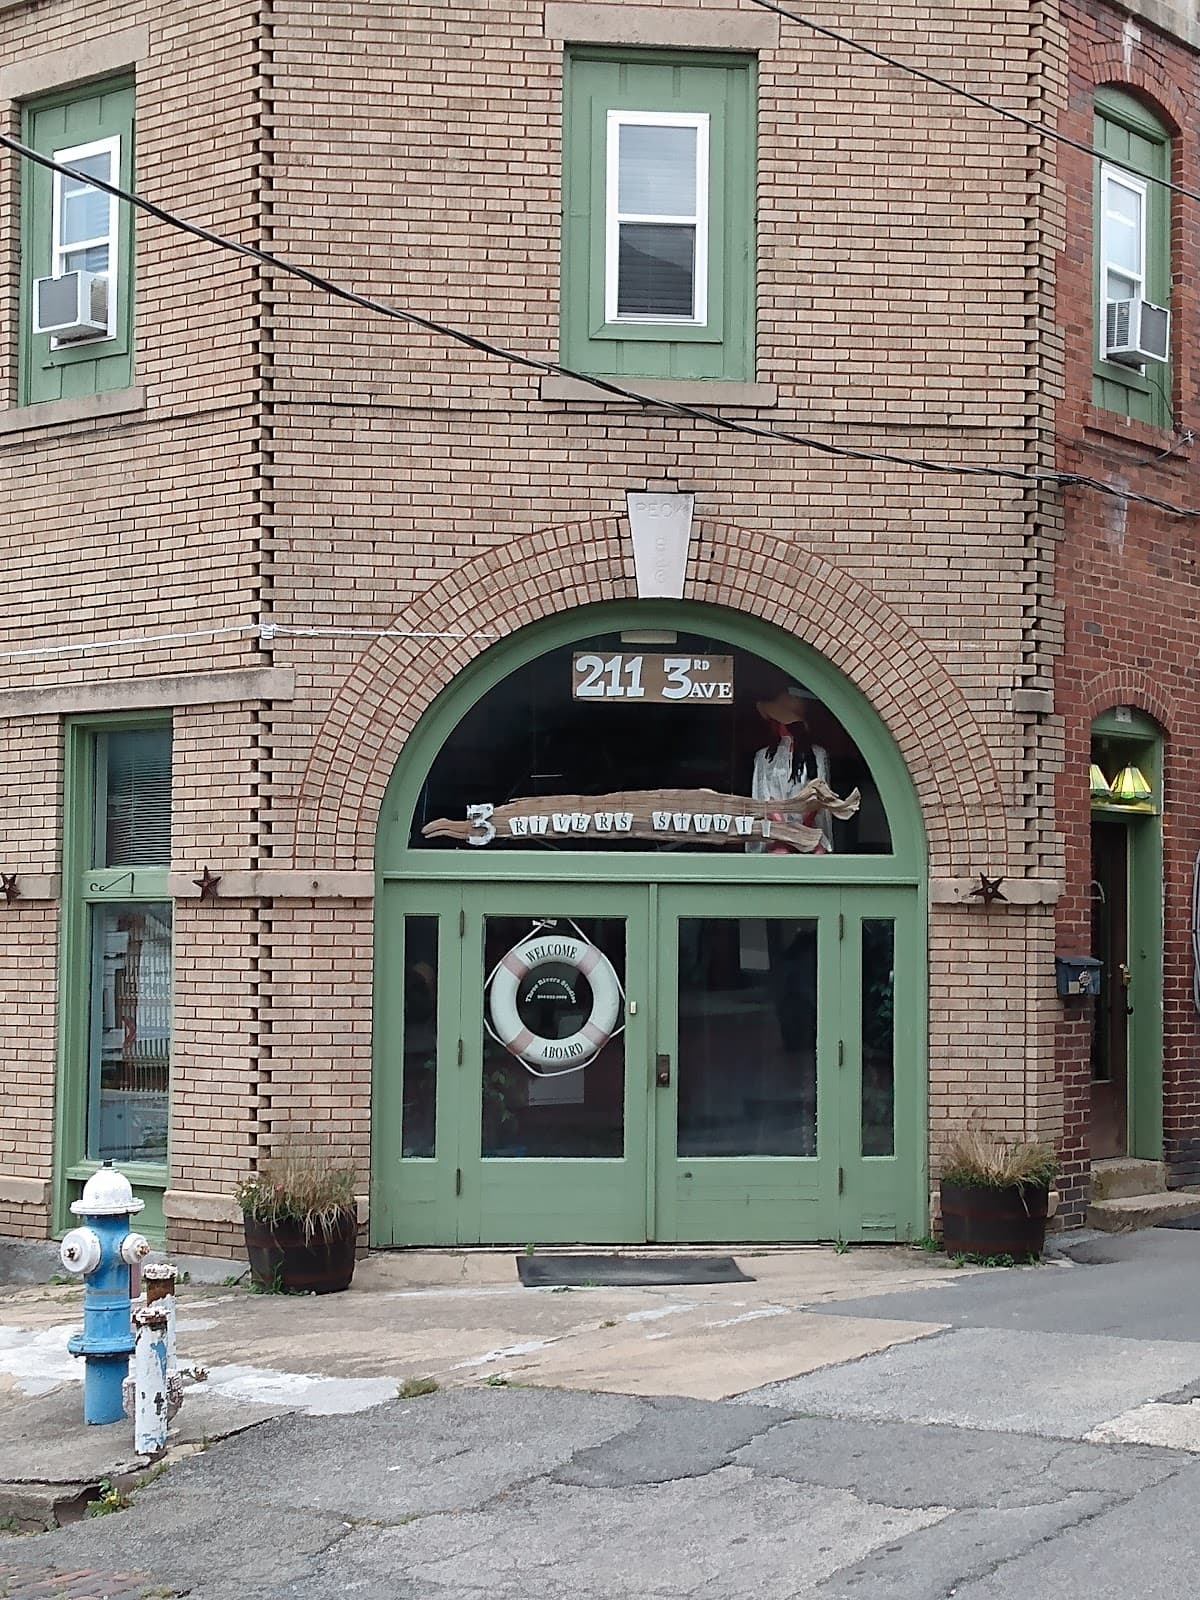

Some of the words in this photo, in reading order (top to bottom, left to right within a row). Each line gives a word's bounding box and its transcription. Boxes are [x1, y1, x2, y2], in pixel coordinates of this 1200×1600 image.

[575, 655, 645, 698] 211
[688, 682, 732, 699] AVE
[466, 803, 496, 846] 3
[514, 814, 629, 834] RIVERS
[525, 943, 578, 963] WELCOME
[541, 1042, 584, 1060] ABOARD
